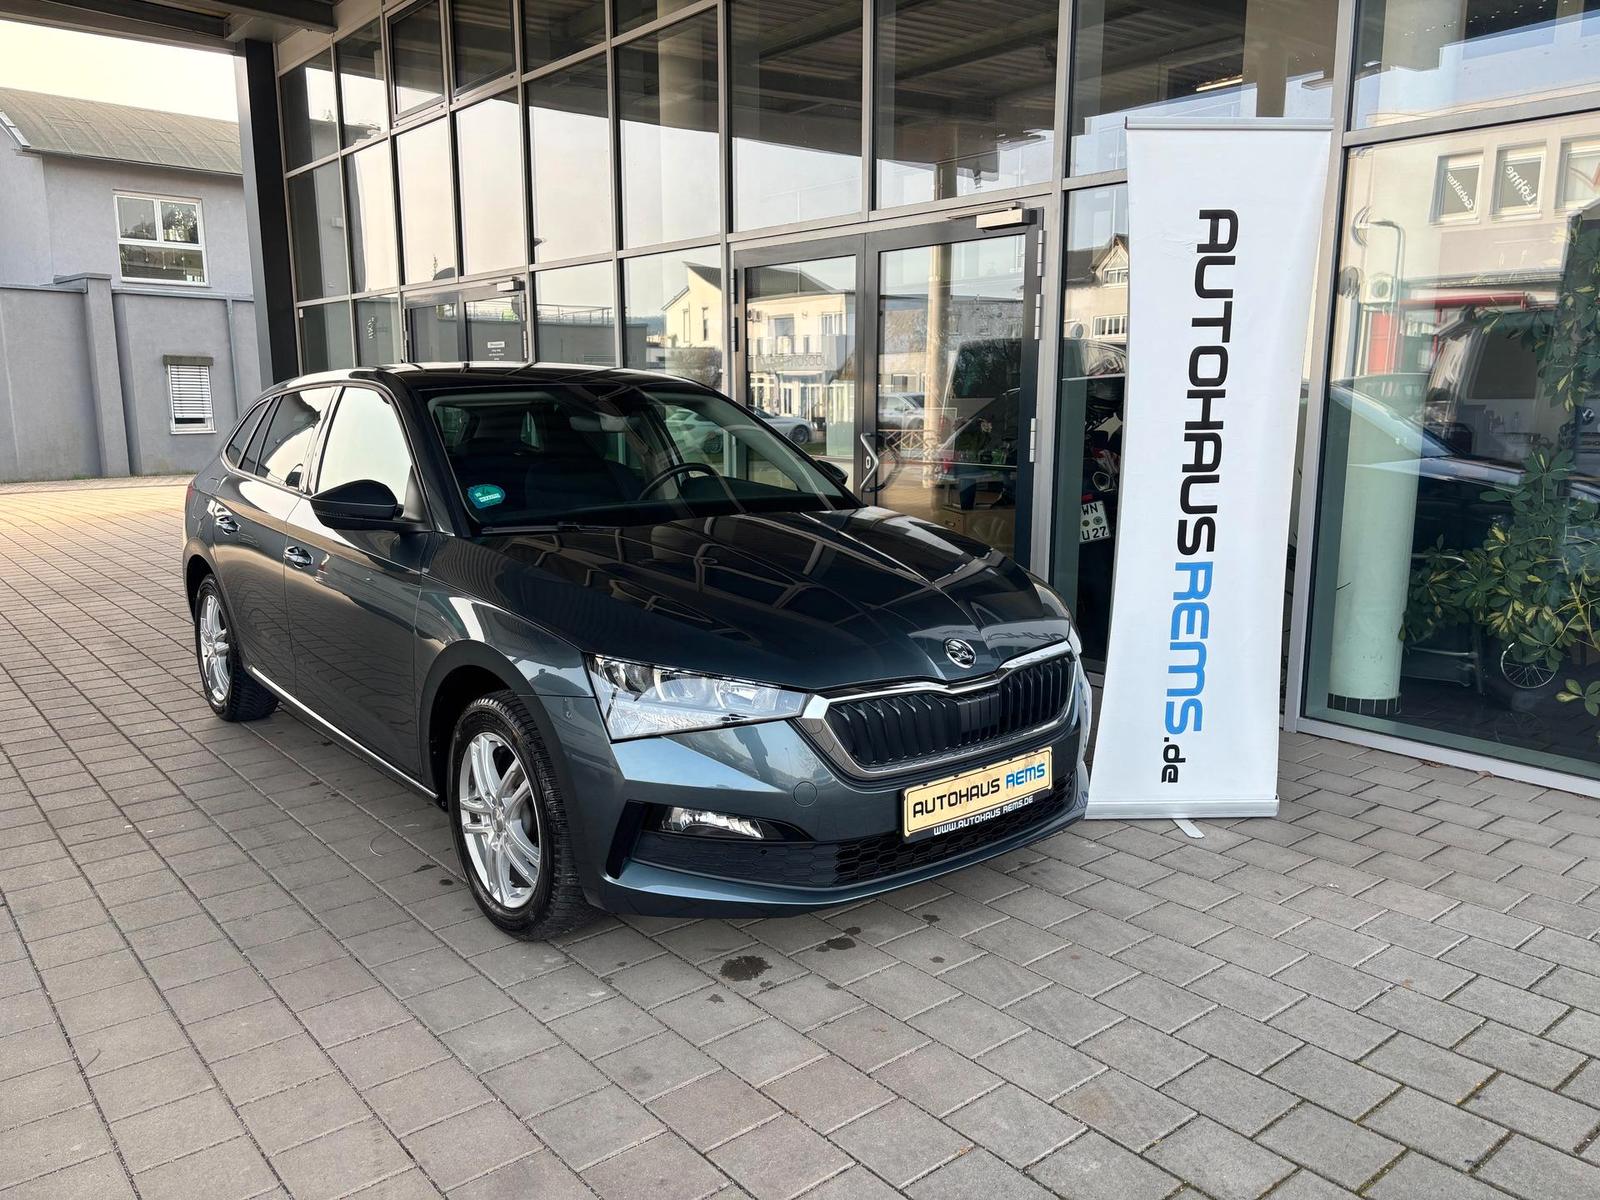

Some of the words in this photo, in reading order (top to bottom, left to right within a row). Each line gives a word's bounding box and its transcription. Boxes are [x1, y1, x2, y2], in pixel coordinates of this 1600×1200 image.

[1082, 503, 1098, 515] WN
[1092, 526, 1107, 538] 27
[913, 778, 1000, 818] AUTOHAUS
[1006, 763, 1046, 789] REMS
